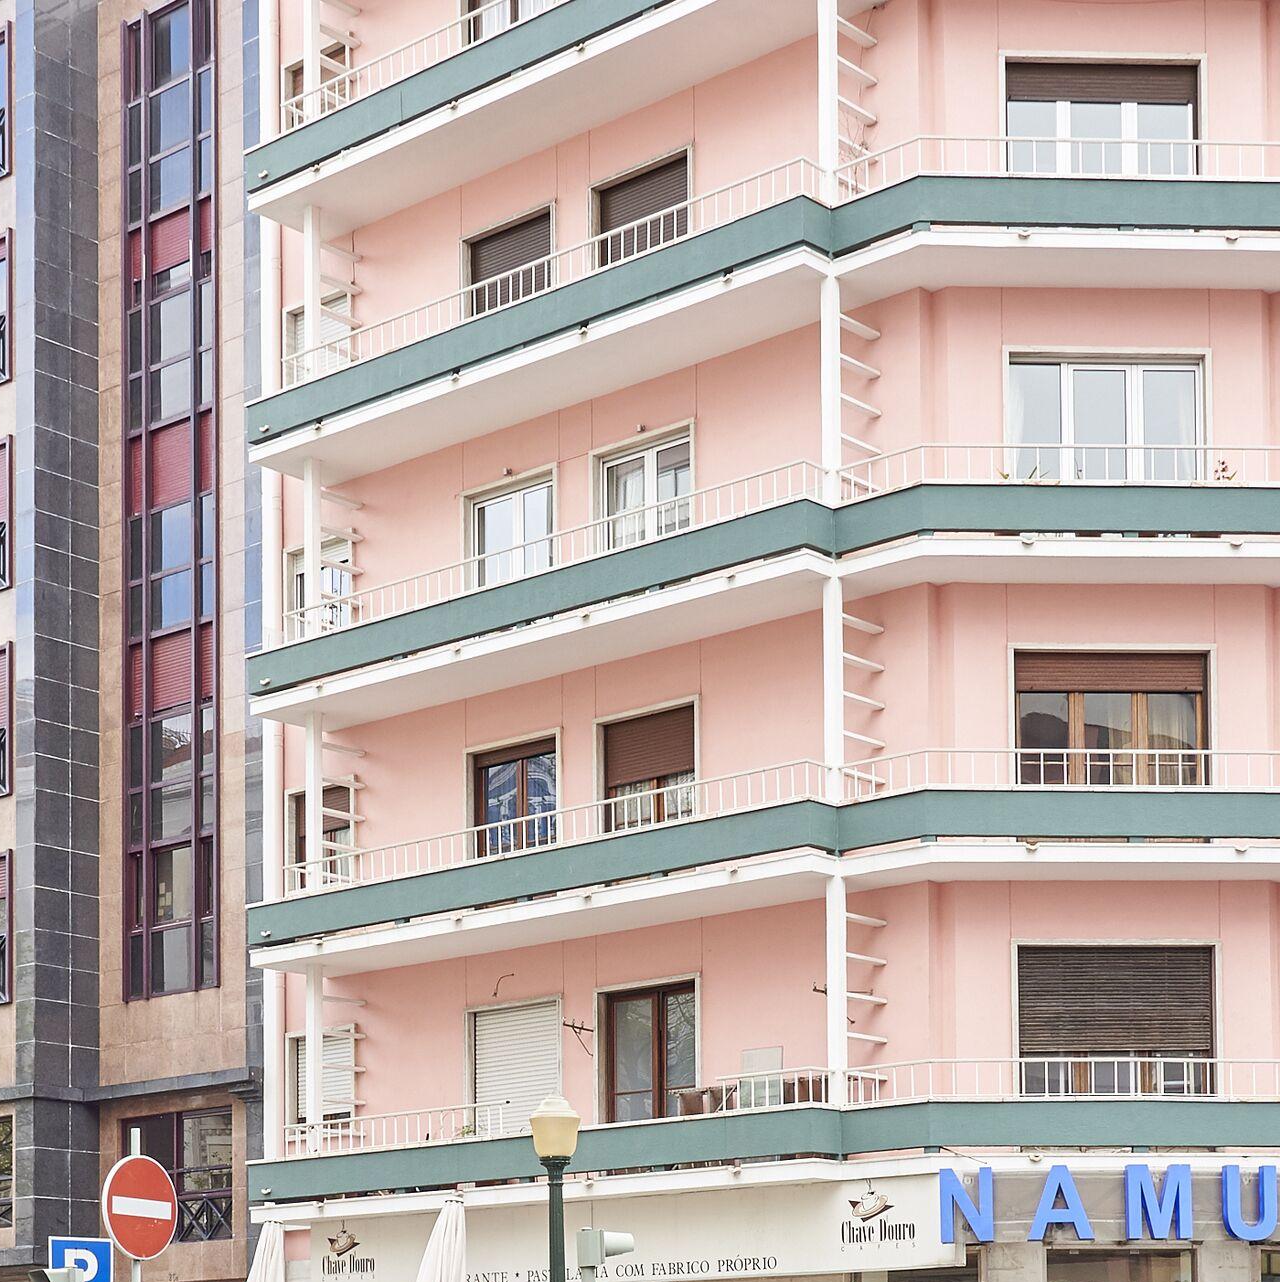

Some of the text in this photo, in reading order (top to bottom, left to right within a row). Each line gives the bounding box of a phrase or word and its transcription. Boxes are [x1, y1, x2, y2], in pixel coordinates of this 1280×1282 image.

[841, 1220, 874, 1244] Chave
[322, 1255, 346, 1276] Chave
[616, 1263, 645, 1278] COM
[652, 1260, 710, 1276] FABRICO
[717, 1254, 778, 1273] PRÓPRIO
